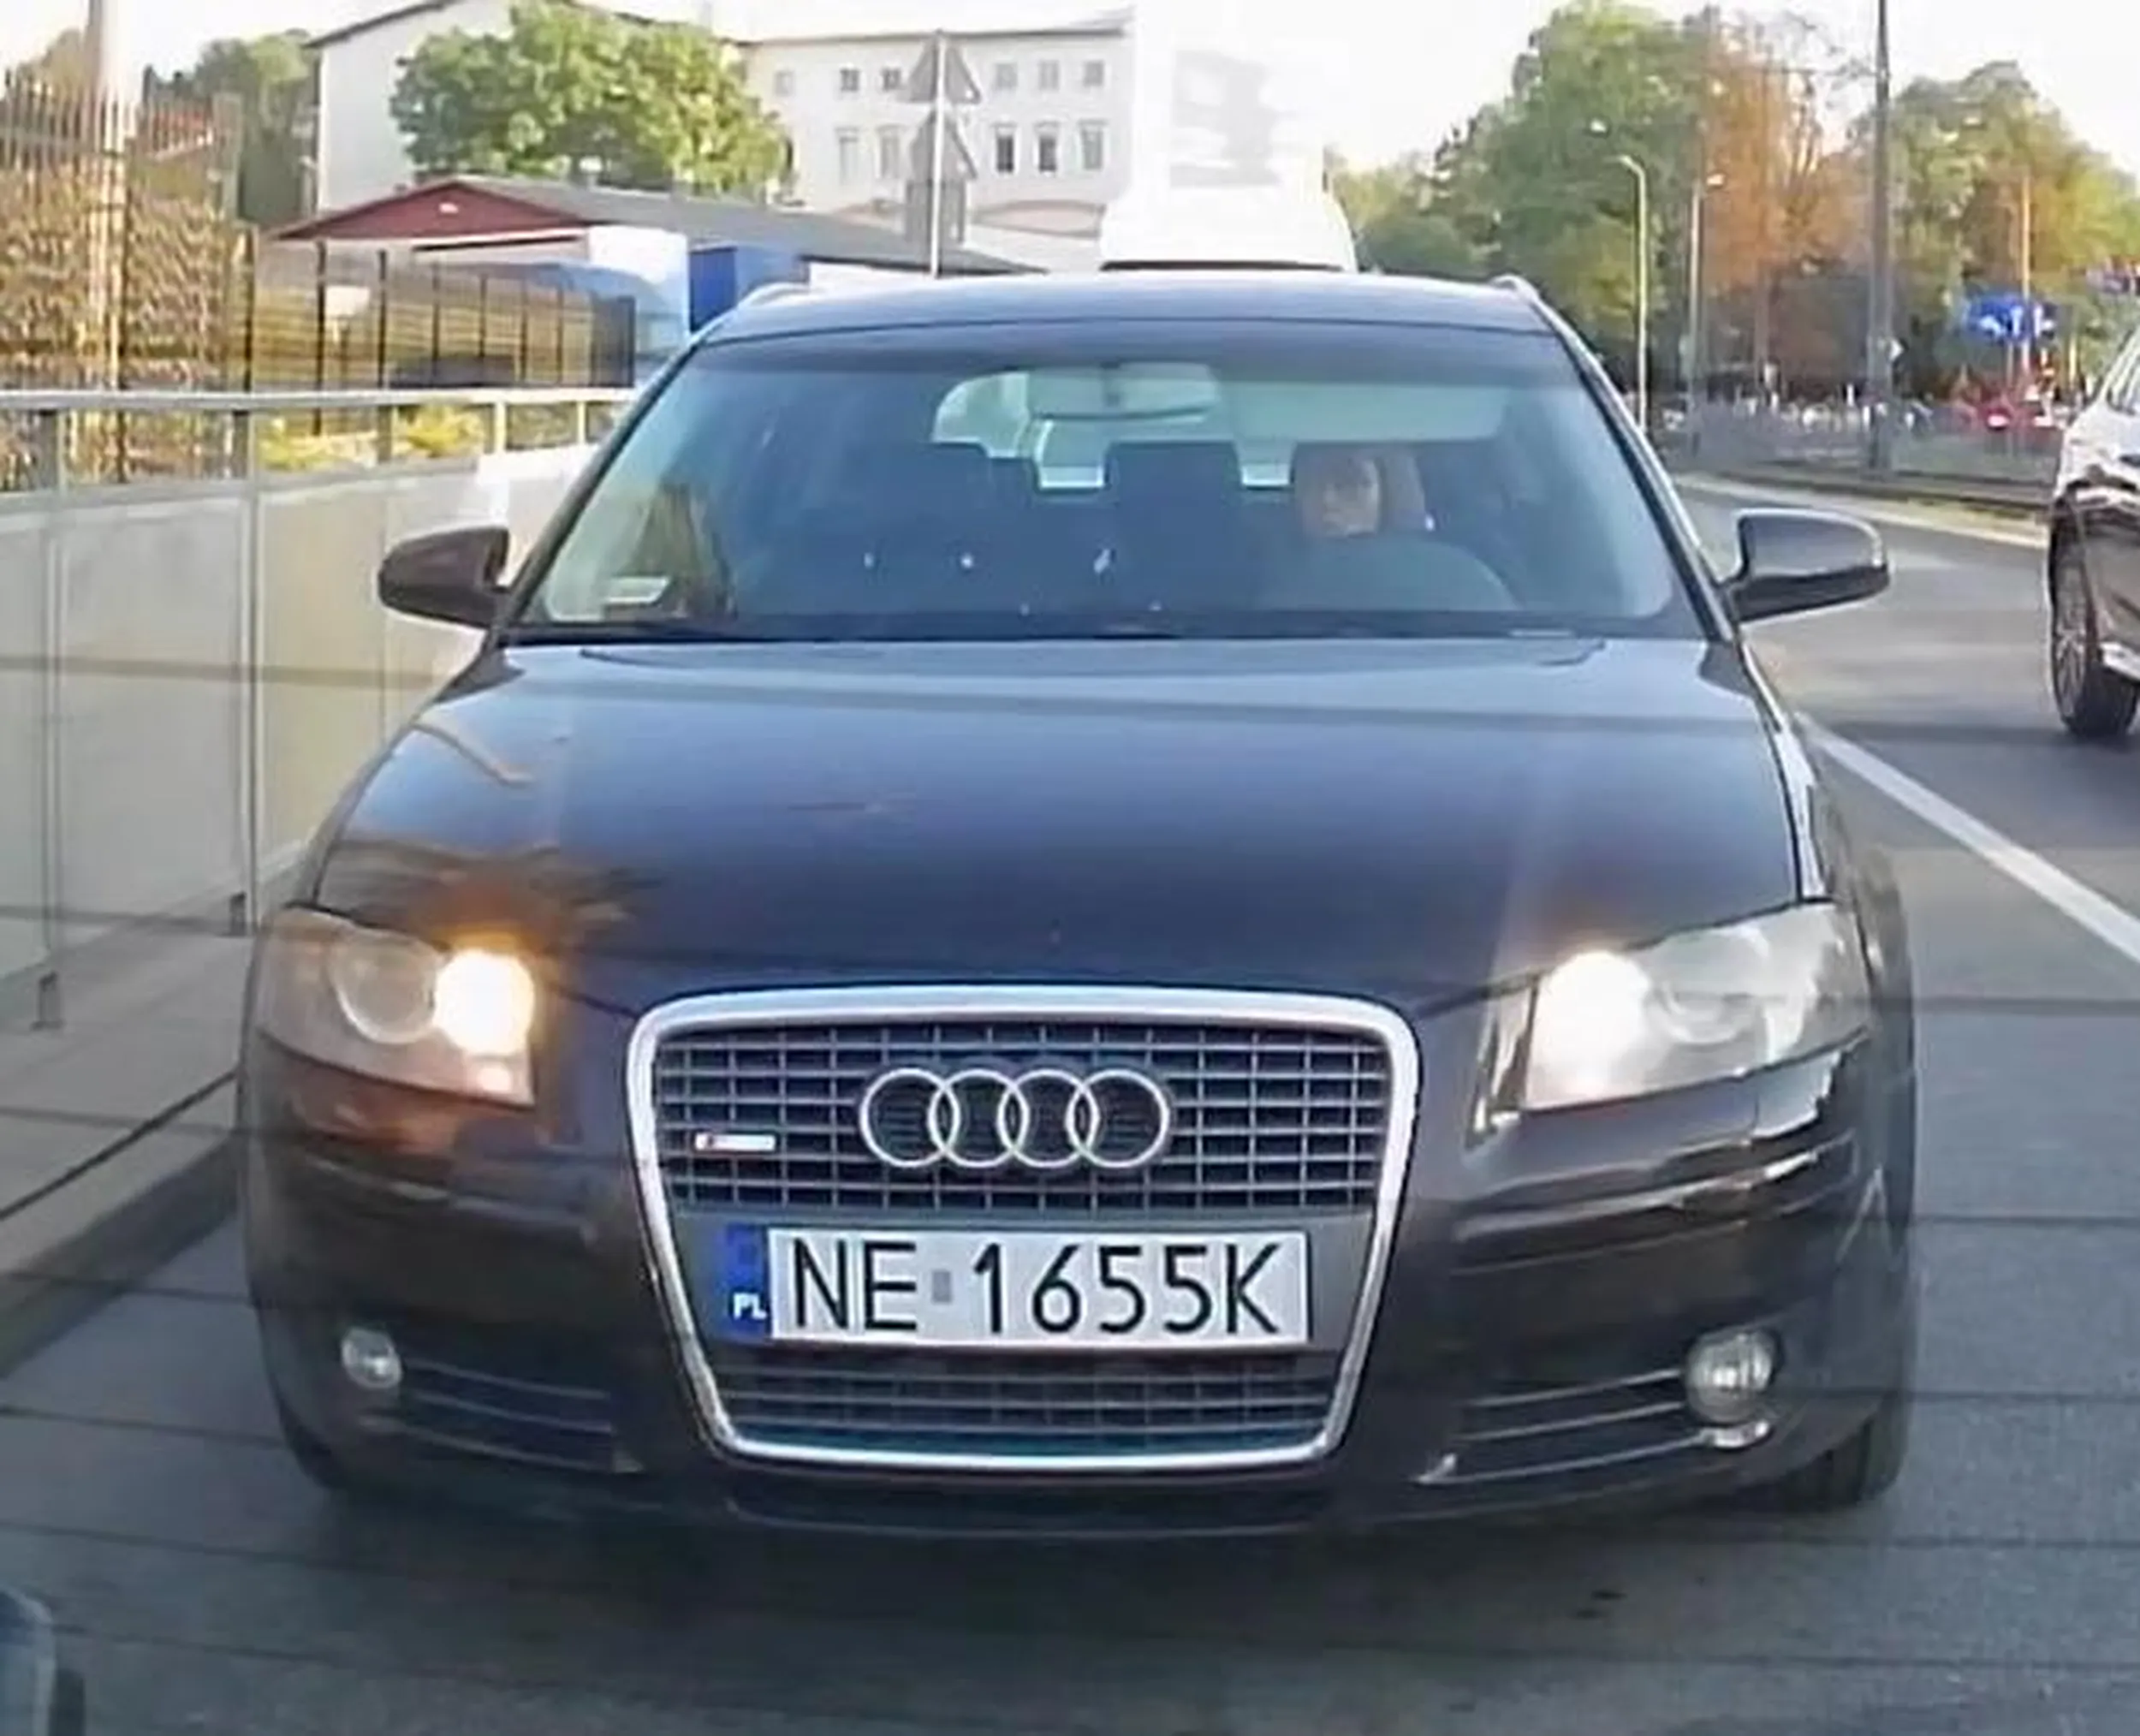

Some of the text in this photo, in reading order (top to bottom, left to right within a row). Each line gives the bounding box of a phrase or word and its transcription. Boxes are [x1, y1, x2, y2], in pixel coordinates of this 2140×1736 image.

[733, 1291, 768, 1320] PL
[793, 1238, 1281, 1335] NE 1655K
